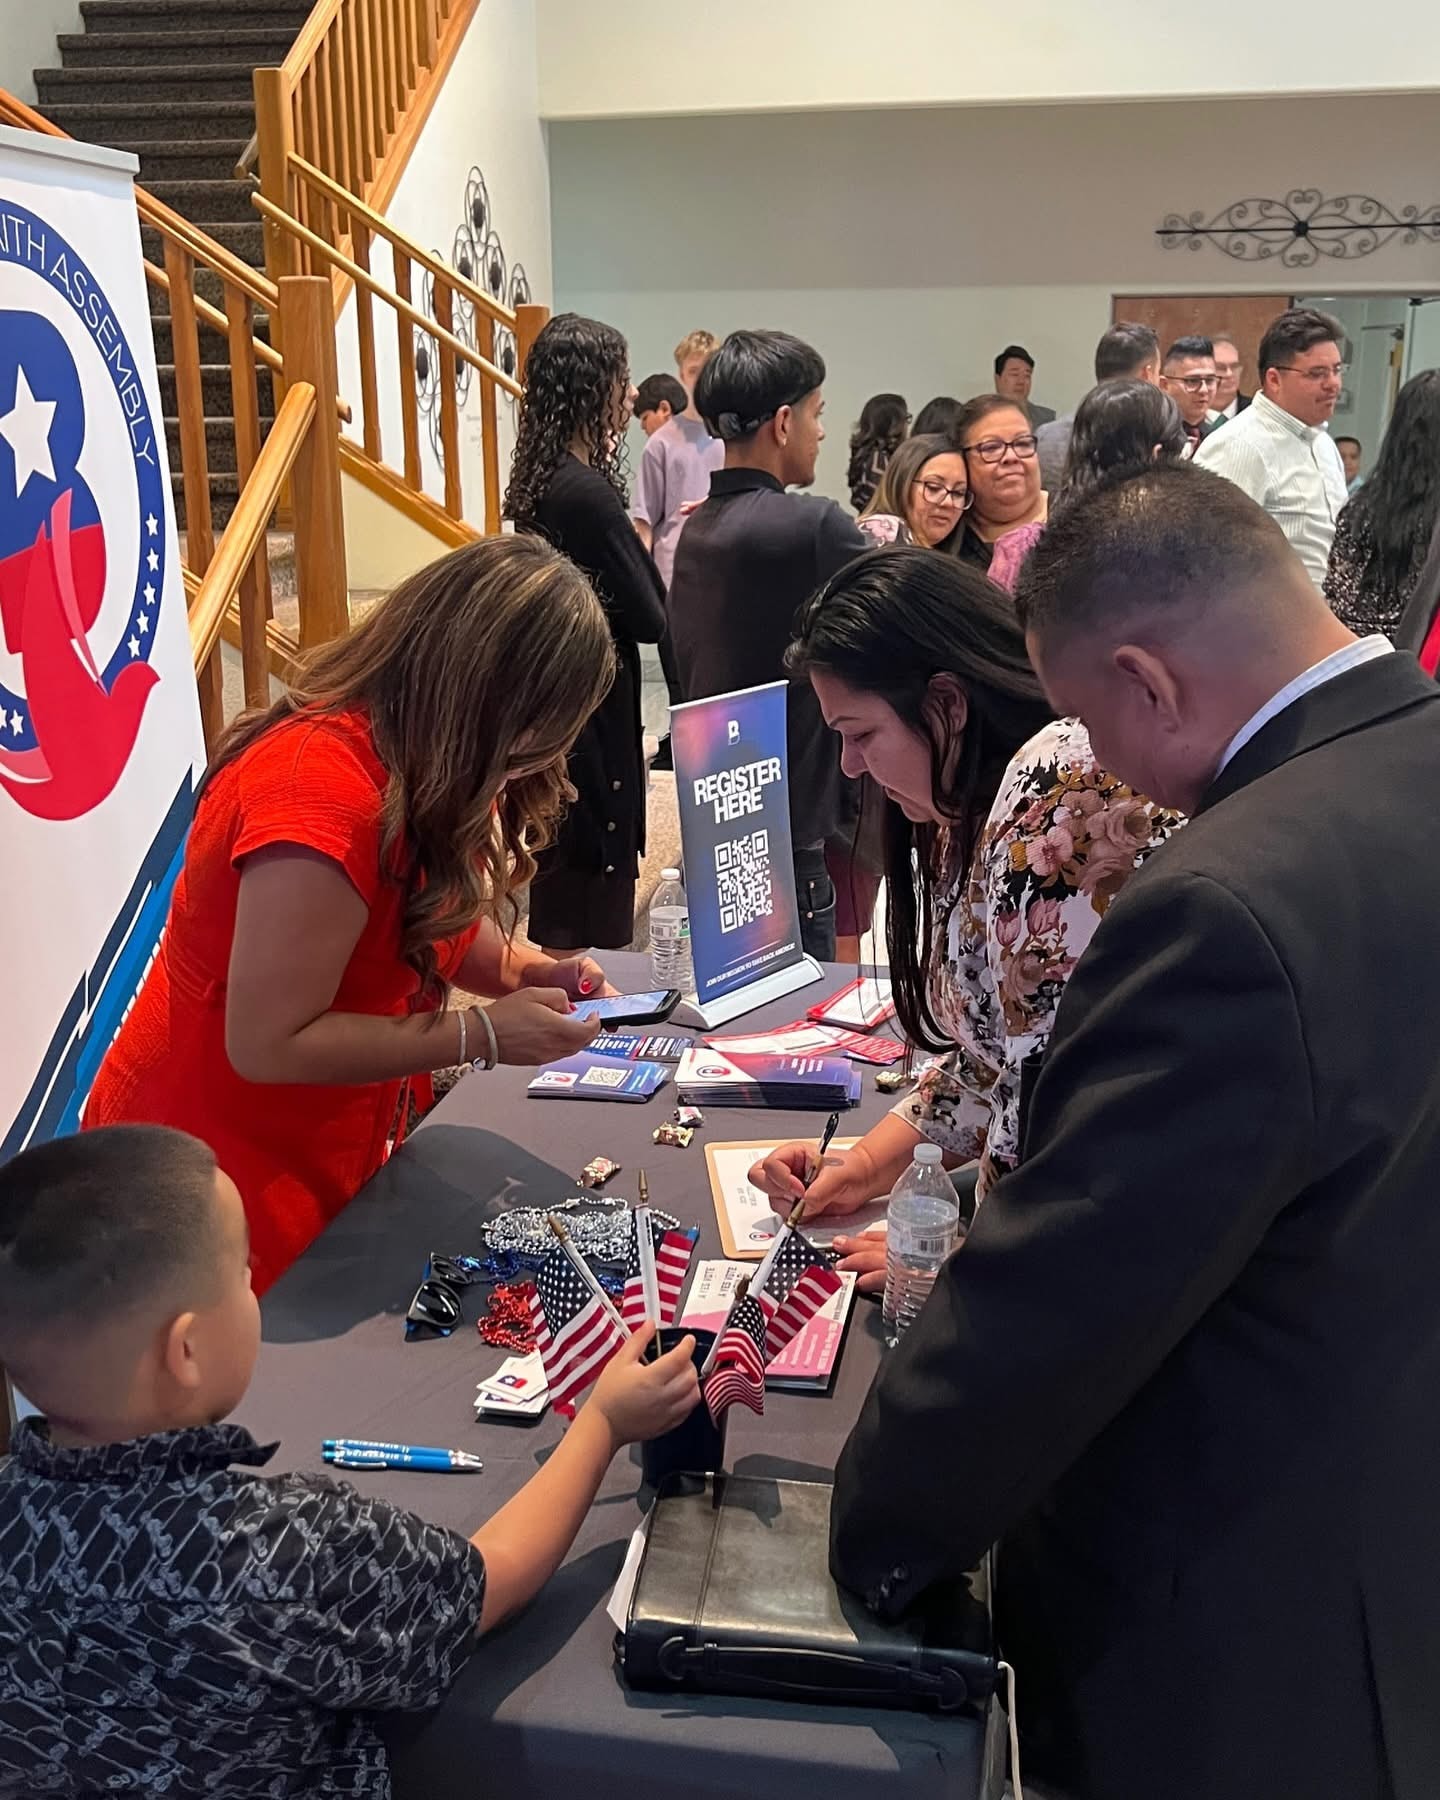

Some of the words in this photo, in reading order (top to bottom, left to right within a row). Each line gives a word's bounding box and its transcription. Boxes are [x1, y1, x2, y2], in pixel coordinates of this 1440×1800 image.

[0, 213, 45, 270] ITH
[50, 253, 154, 465] ASSEMBLY
[693, 757, 782, 806] REGISTER
[713, 786, 764, 824] HERE
